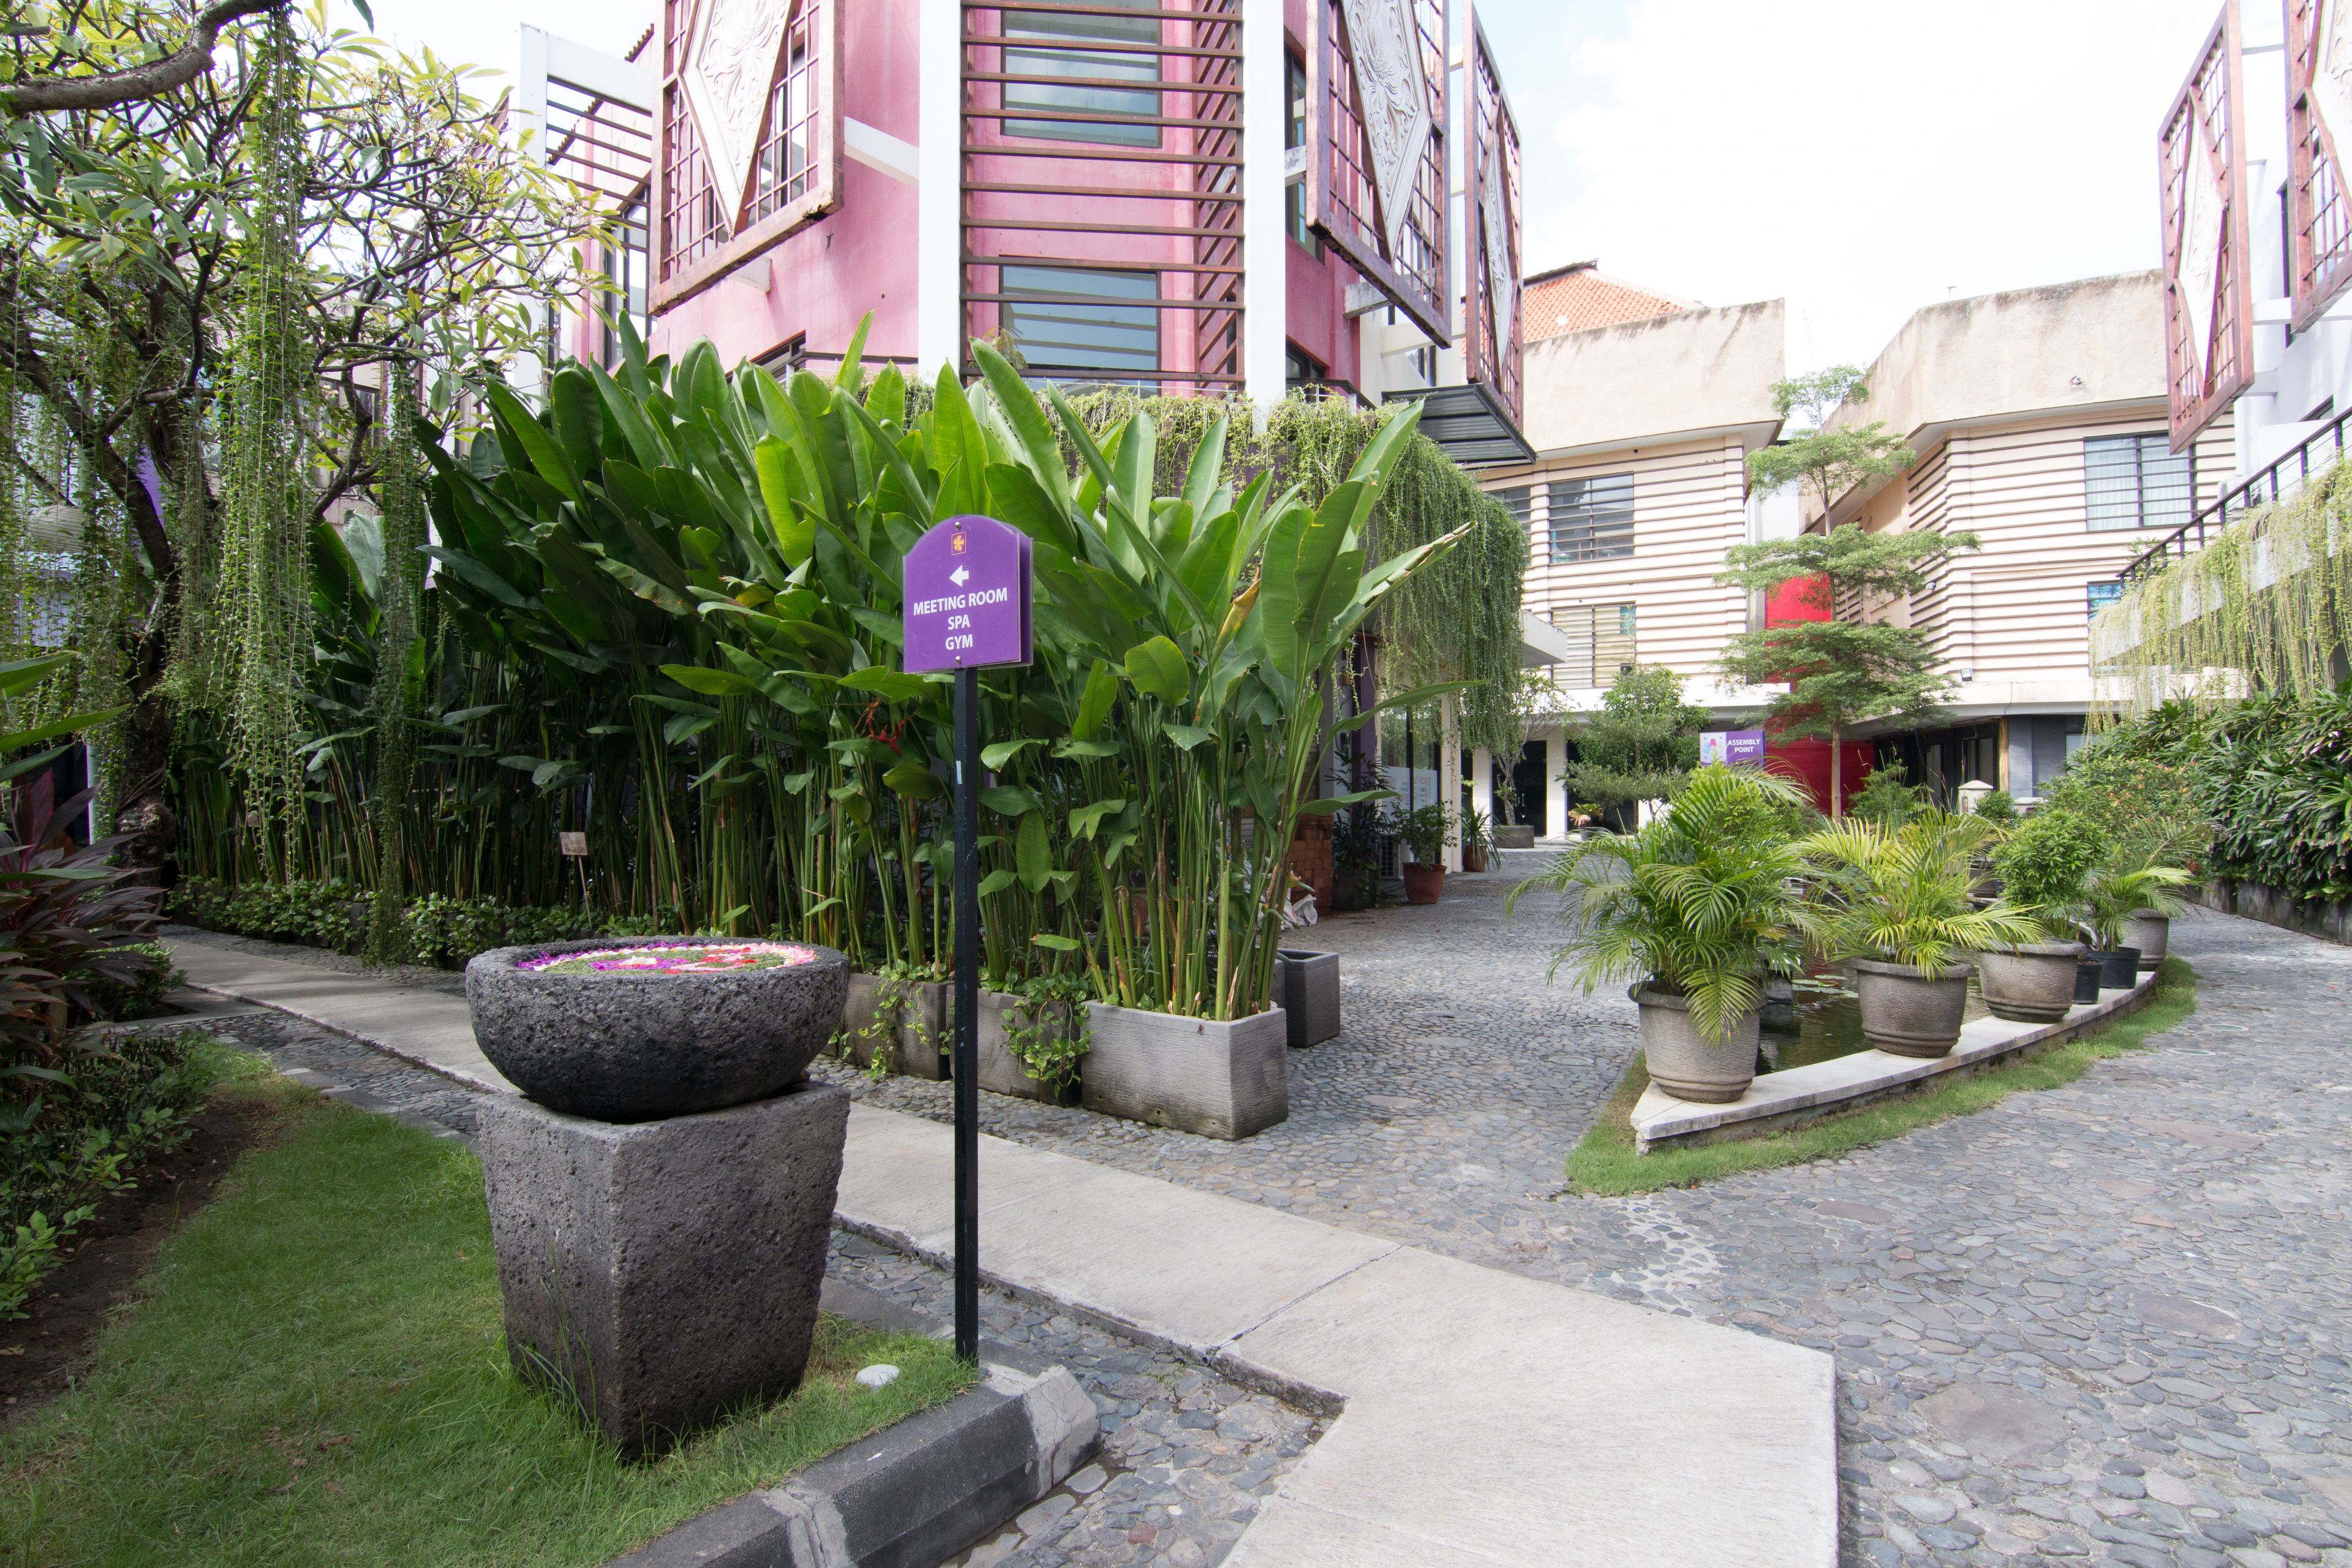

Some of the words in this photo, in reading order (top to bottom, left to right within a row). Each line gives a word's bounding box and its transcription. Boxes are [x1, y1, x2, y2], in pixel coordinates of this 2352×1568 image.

[913, 594, 966, 616] MEETING
[968, 587, 1008, 607] ROOM
[948, 614, 970, 630] SPA
[945, 634, 973, 650] GYM
